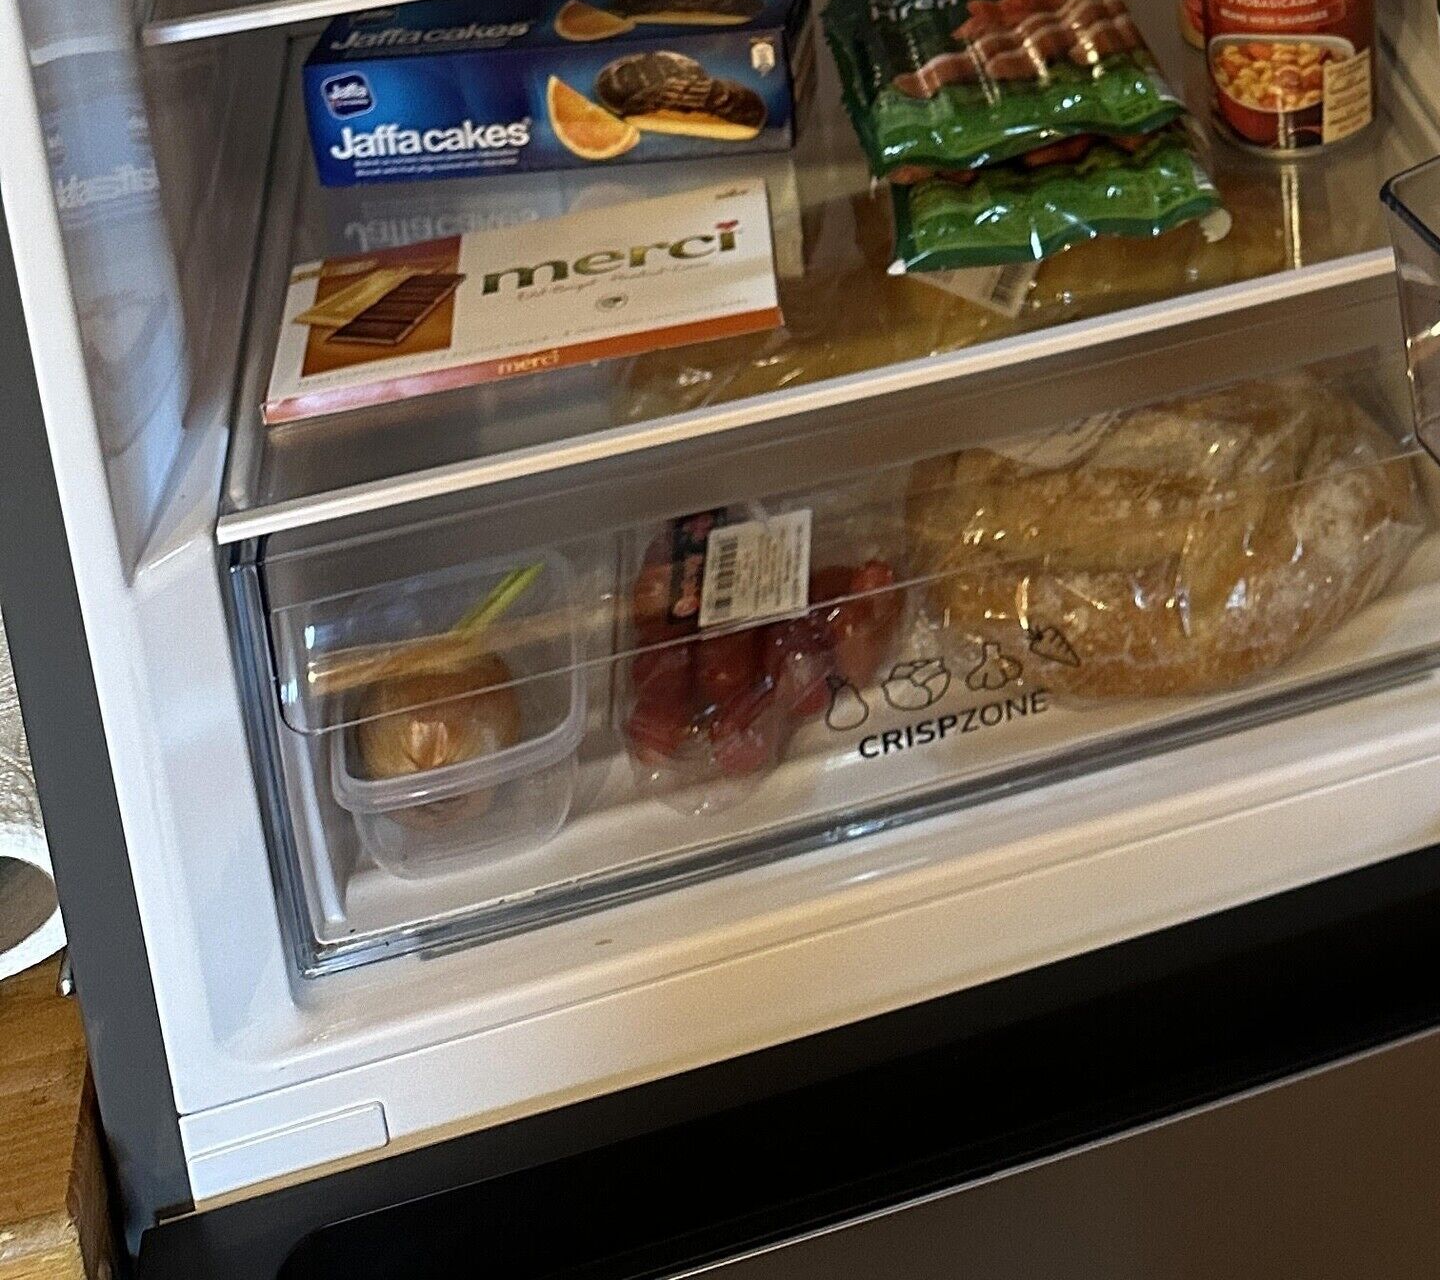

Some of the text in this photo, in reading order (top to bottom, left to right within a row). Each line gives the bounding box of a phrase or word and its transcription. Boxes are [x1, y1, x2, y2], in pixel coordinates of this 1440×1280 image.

[481, 219, 739, 297] merci
[498, 349, 561, 377] merci
[859, 686, 1050, 760] CRISPZONE
